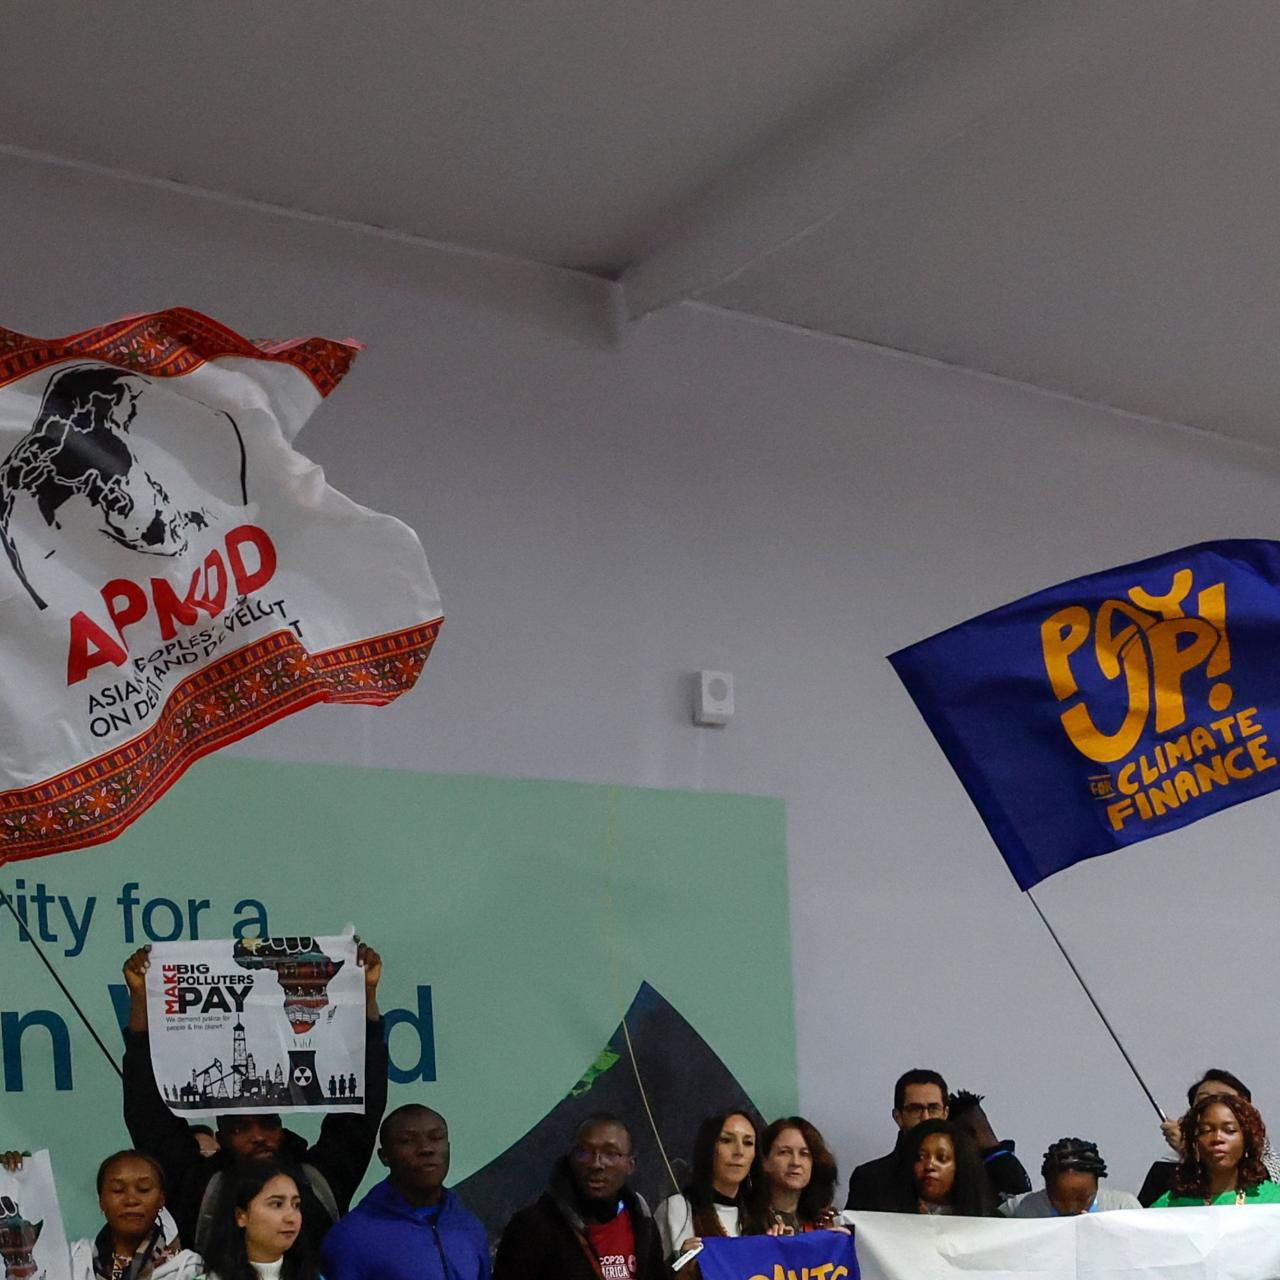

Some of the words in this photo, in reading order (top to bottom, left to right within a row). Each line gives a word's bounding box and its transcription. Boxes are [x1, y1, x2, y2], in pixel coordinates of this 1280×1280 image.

[1041, 568, 1193, 701] PAY
[90, 708, 132, 737] ON
[153, 652, 199, 683] AND
[1117, 707, 1263, 795] CLIMATE
[1107, 735, 1278, 831] FINANCE
[117, 882, 210, 943] for
[232, 899, 268, 939] a
[162, 964, 178, 1014] MAKE
[176, 964, 210, 974] BIG
[177, 975, 254, 986] POLLUTERS
[178, 985, 253, 1014] PAY
